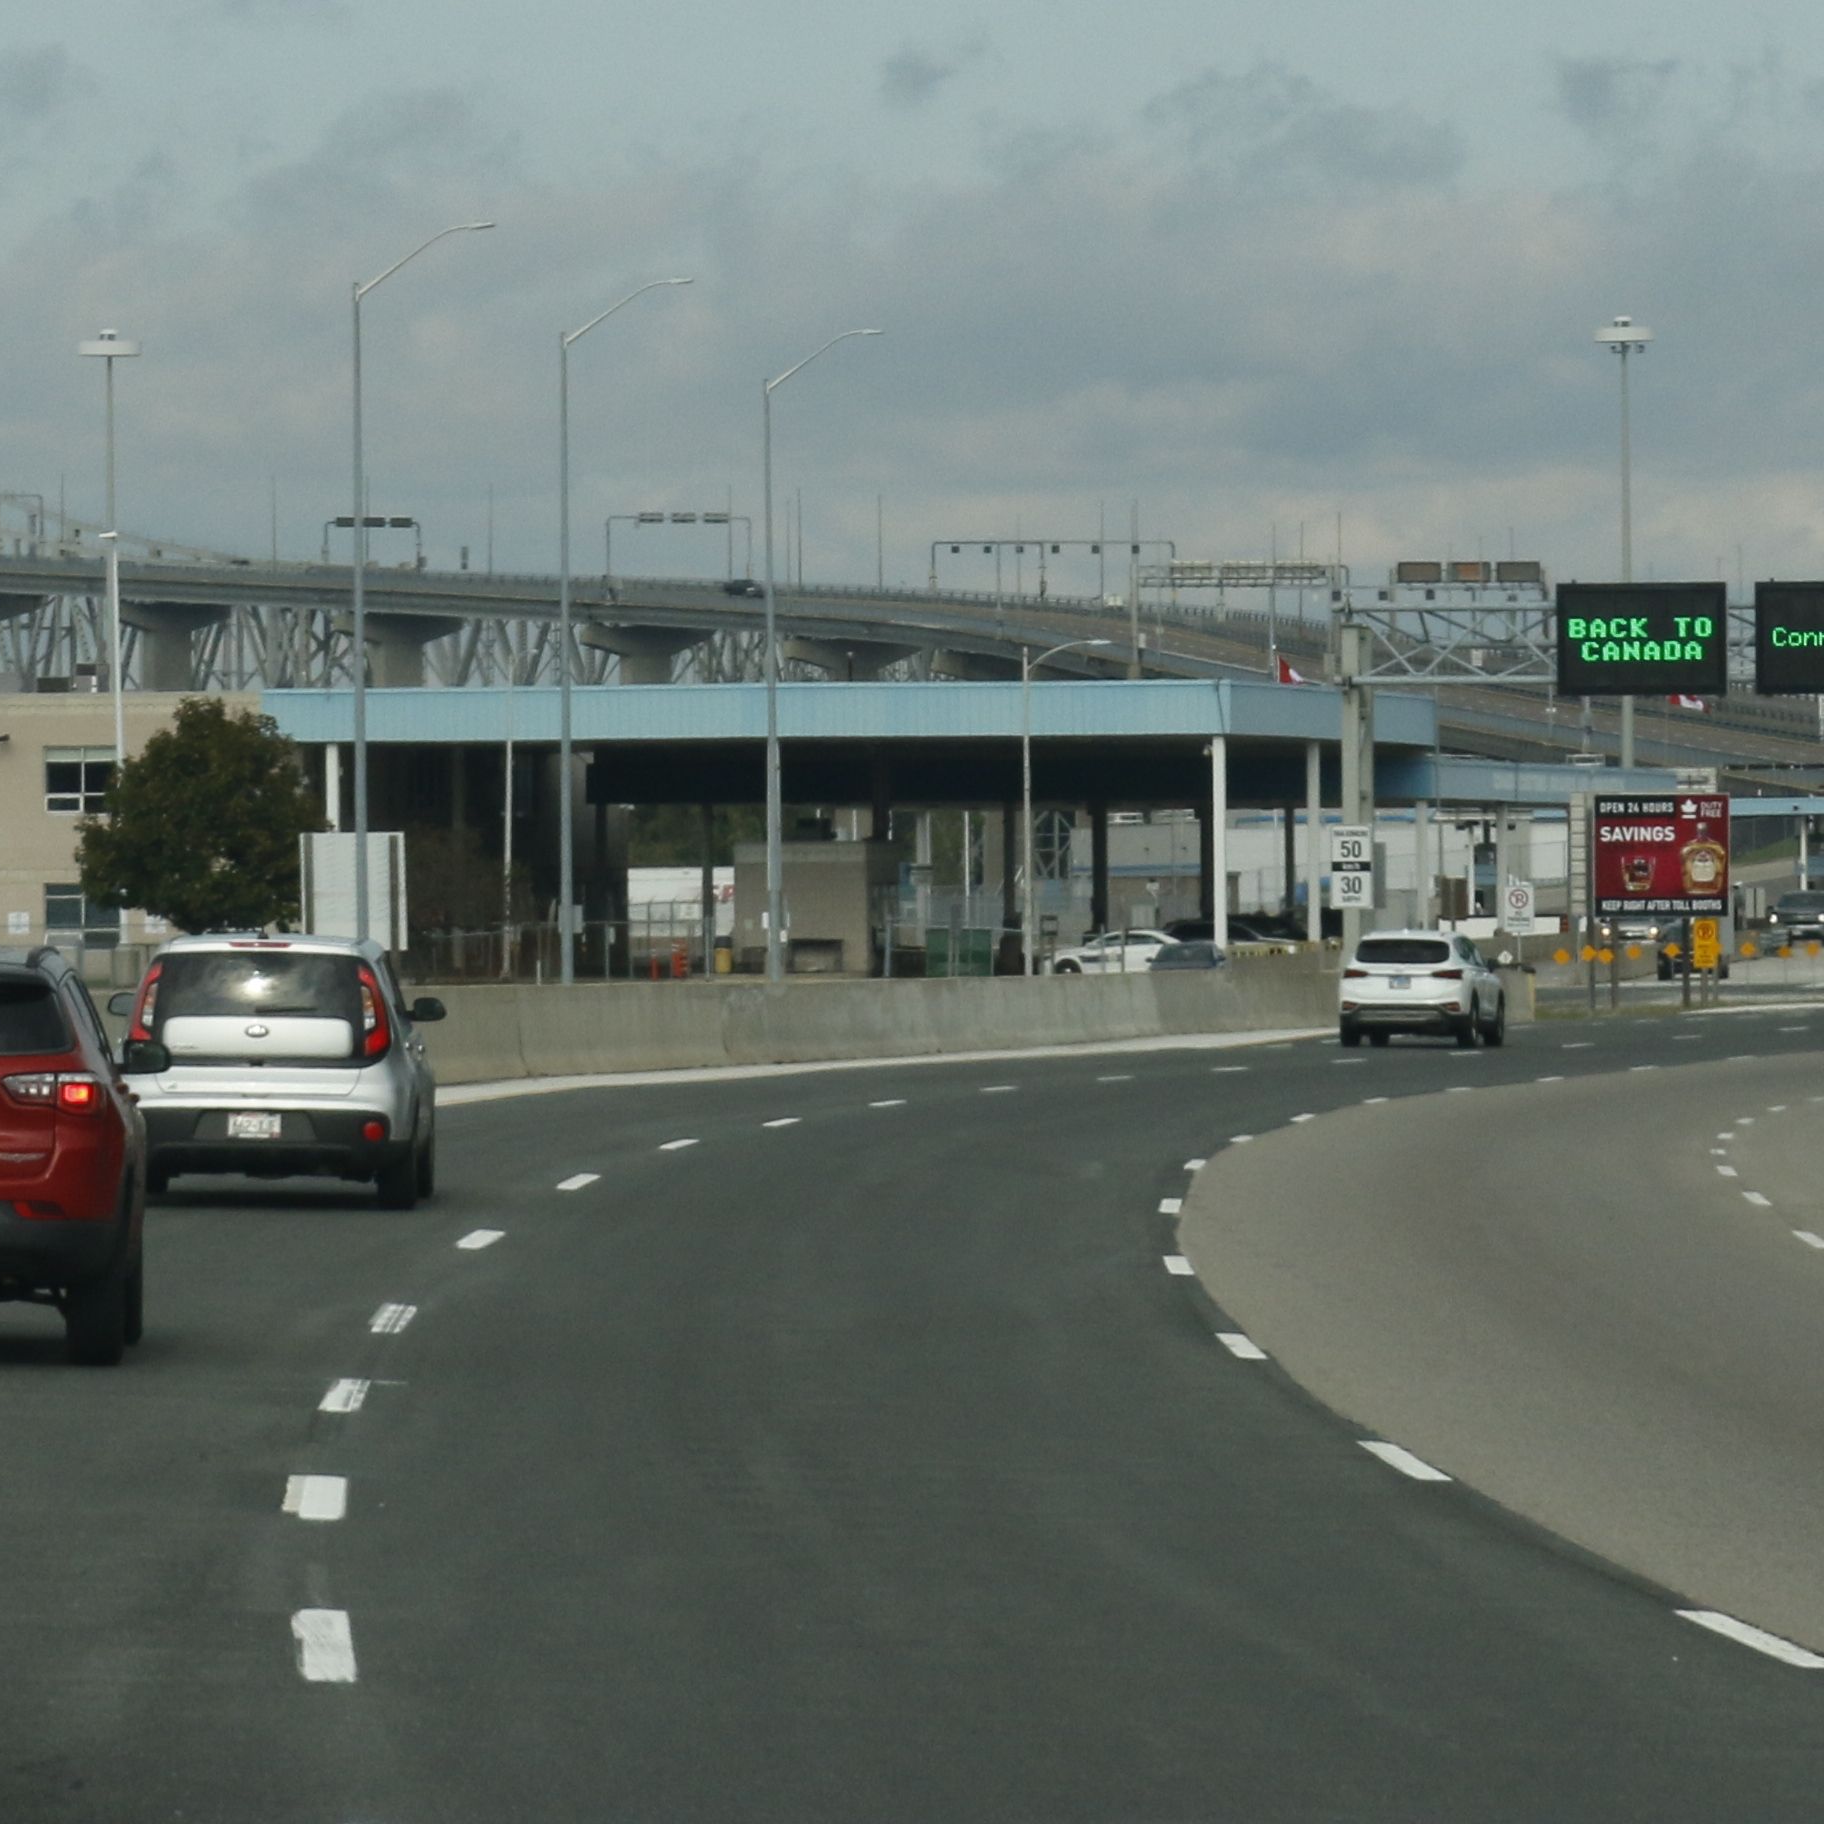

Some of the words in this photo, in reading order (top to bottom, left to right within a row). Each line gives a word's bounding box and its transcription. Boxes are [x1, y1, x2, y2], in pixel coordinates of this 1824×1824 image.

[1568, 618, 1648, 638] BACK
[1674, 617, 1712, 637] TO
[1582, 641, 1702, 661] CANADA
[1600, 802, 1624, 813] OPEN
[1627, 802, 1639, 813] 24
[1642, 802, 1674, 813] HOURS
[1700, 801, 1723, 810] DUTY
[1700, 809, 1722, 817] FREE
[1600, 826, 1675, 842] SAVINGS
[1341, 840, 1362, 858] 50
[1341, 876, 1362, 894] 30
[1601, 900, 1622, 911] KEEP
[1623, 900, 1645, 911] RIGHT
[1647, 900, 1671, 911] AFTER
[1672, 900, 1690, 911] TOLL
